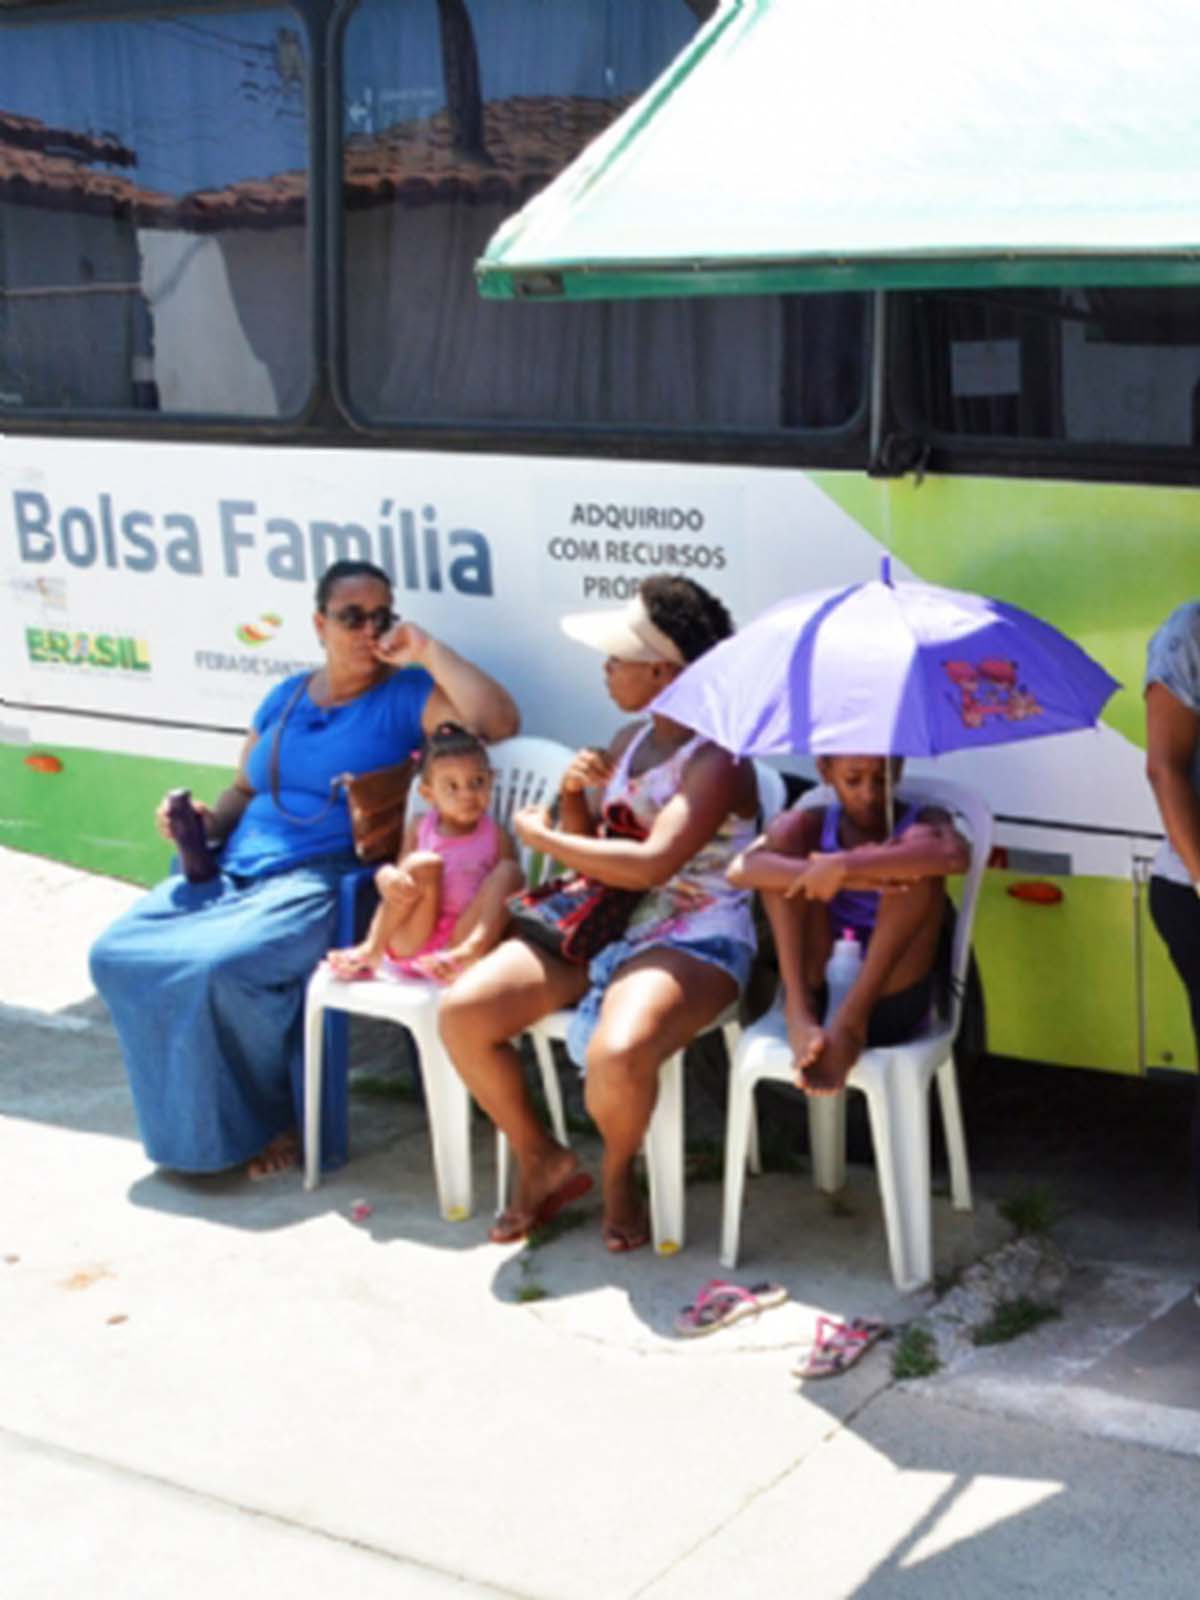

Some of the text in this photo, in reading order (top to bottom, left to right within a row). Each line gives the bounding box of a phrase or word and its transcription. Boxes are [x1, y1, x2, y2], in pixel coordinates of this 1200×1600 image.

[570, 503, 705, 532] ADQUIRIDO
[13, 489, 494, 598] Bolsa Família
[548, 537, 727, 570] COM RECURSOS
[583, 574, 643, 600] PRÓP
[24, 624, 152, 673] BRASIL
